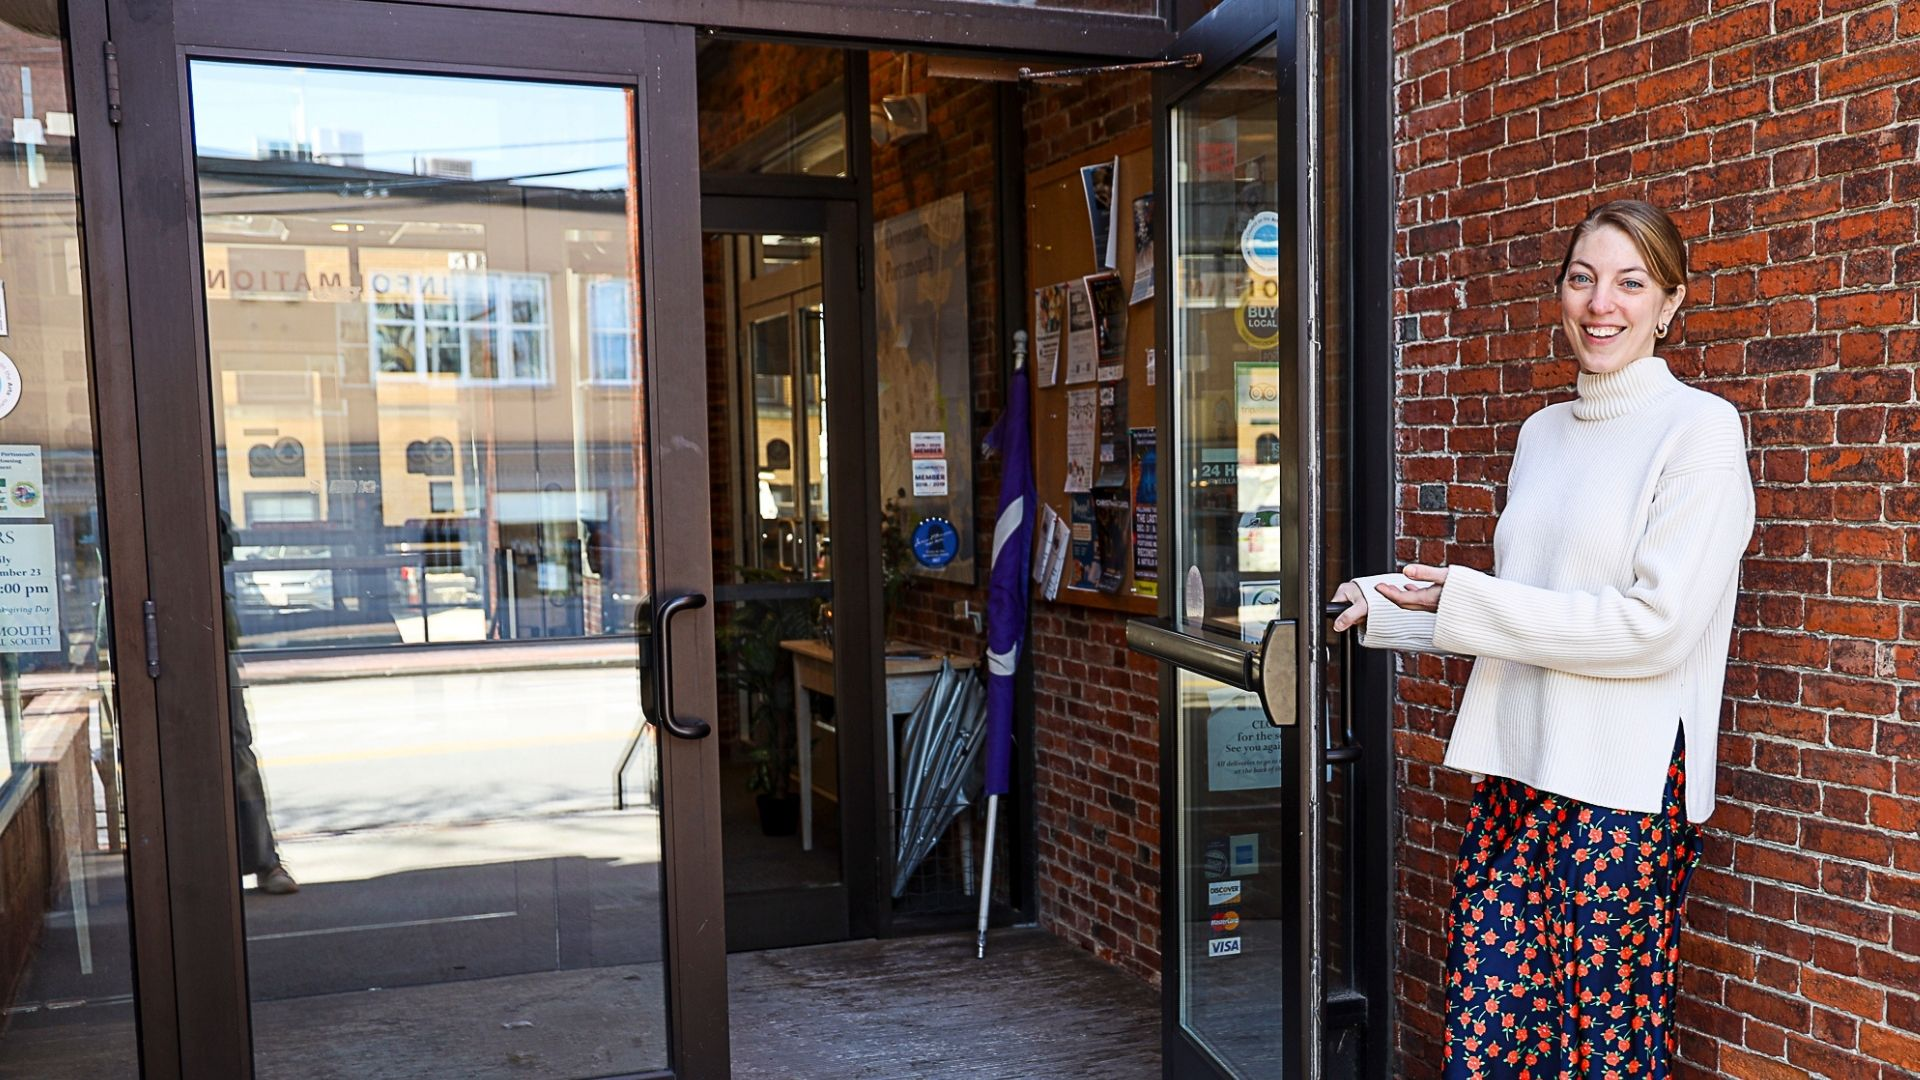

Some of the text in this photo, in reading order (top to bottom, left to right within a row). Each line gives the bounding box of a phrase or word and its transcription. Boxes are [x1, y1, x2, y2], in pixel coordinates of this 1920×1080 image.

[1247, 307, 1277, 318] BUY
[1248, 319, 1278, 327] LOCAL
[1202, 464, 1220, 477] 24
[30, 568, 41, 577] 23
[0, 583, 49, 598] :00 pm
[35, 605, 51, 614] Day
[10, 637, 51, 646] SOCIETY
[1237, 732, 1254, 742] for
[1256, 731, 1274, 741] the
[1225, 744, 1241, 753] See
[1244, 745, 1261, 755] you
[1209, 885, 1239, 894] DISCOVER
[1211, 917, 1239, 926] MasterCard
[1212, 940, 1239, 953] VISA
